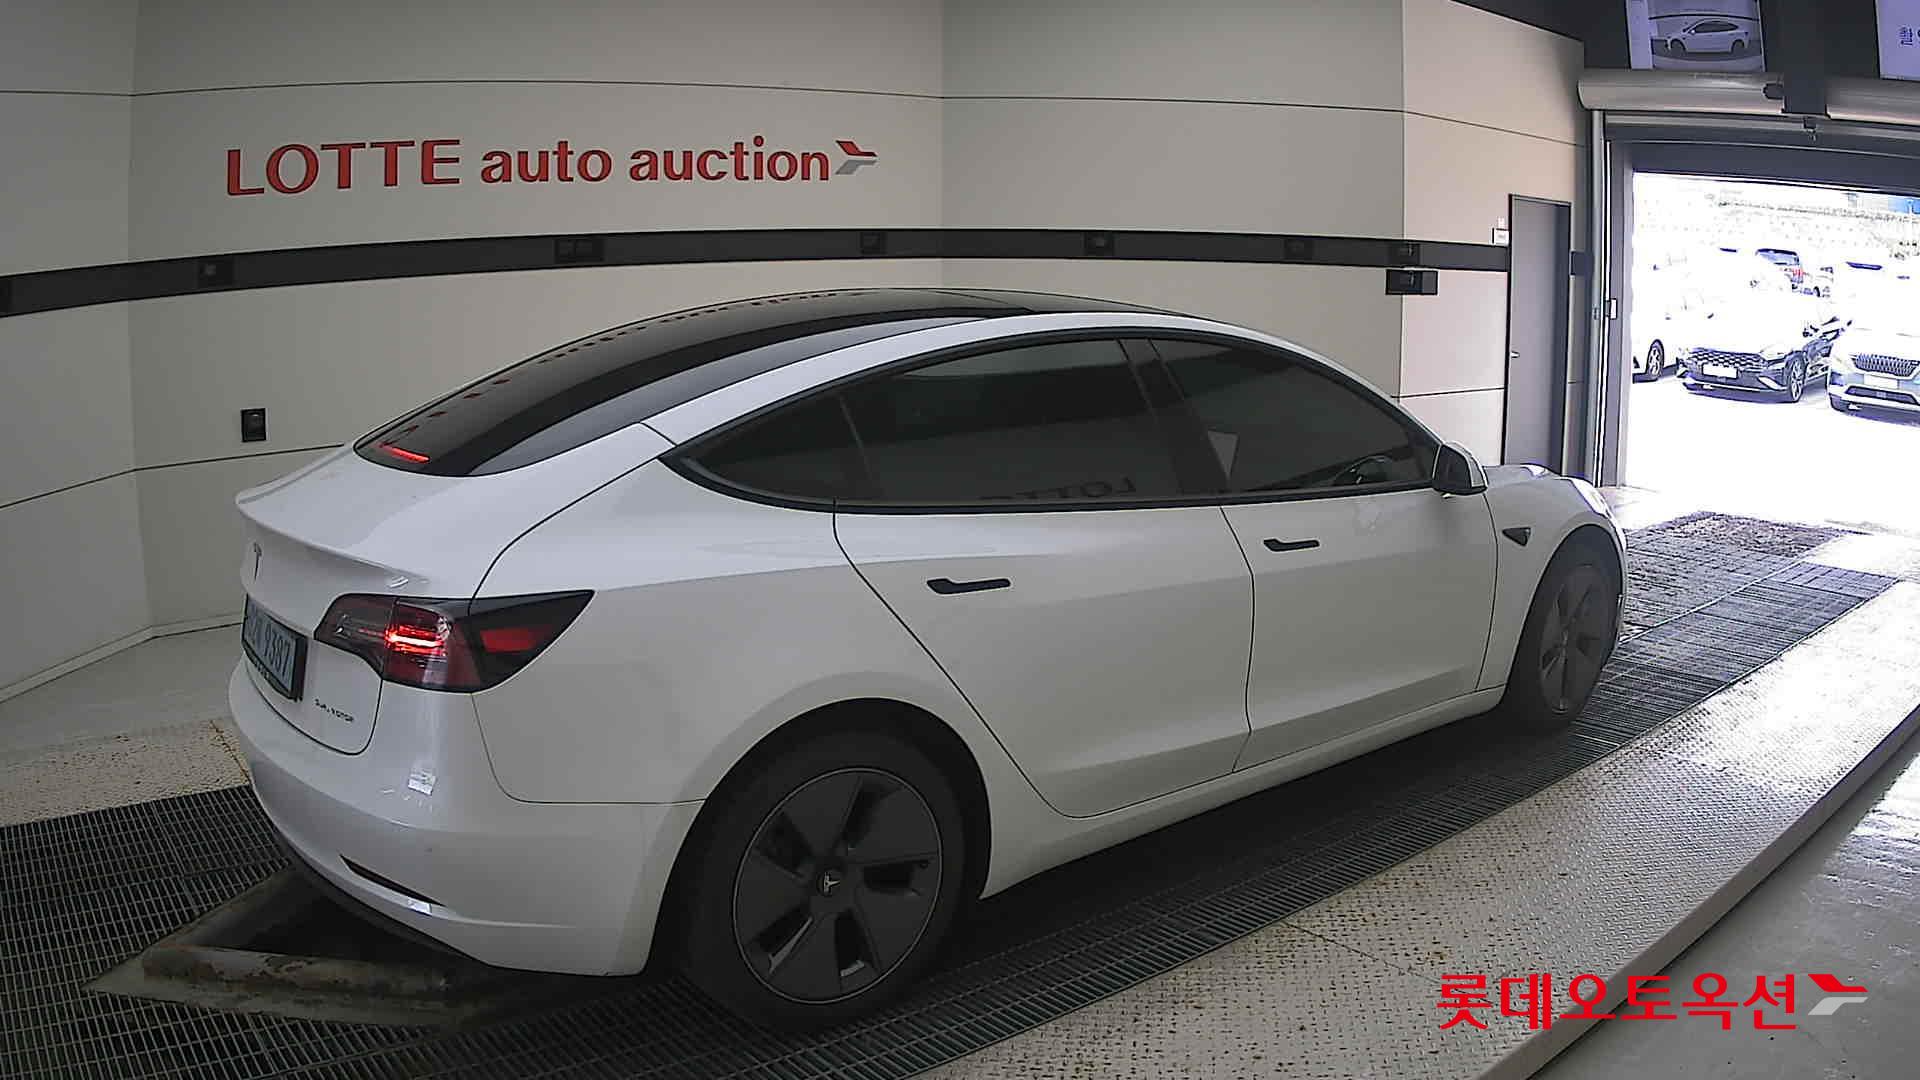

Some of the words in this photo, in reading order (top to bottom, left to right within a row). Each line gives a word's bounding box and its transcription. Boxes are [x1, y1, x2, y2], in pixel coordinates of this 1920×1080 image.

[227, 138, 460, 196] LOTTE
[480, 140, 613, 184] auto
[629, 135, 830, 183] auction
